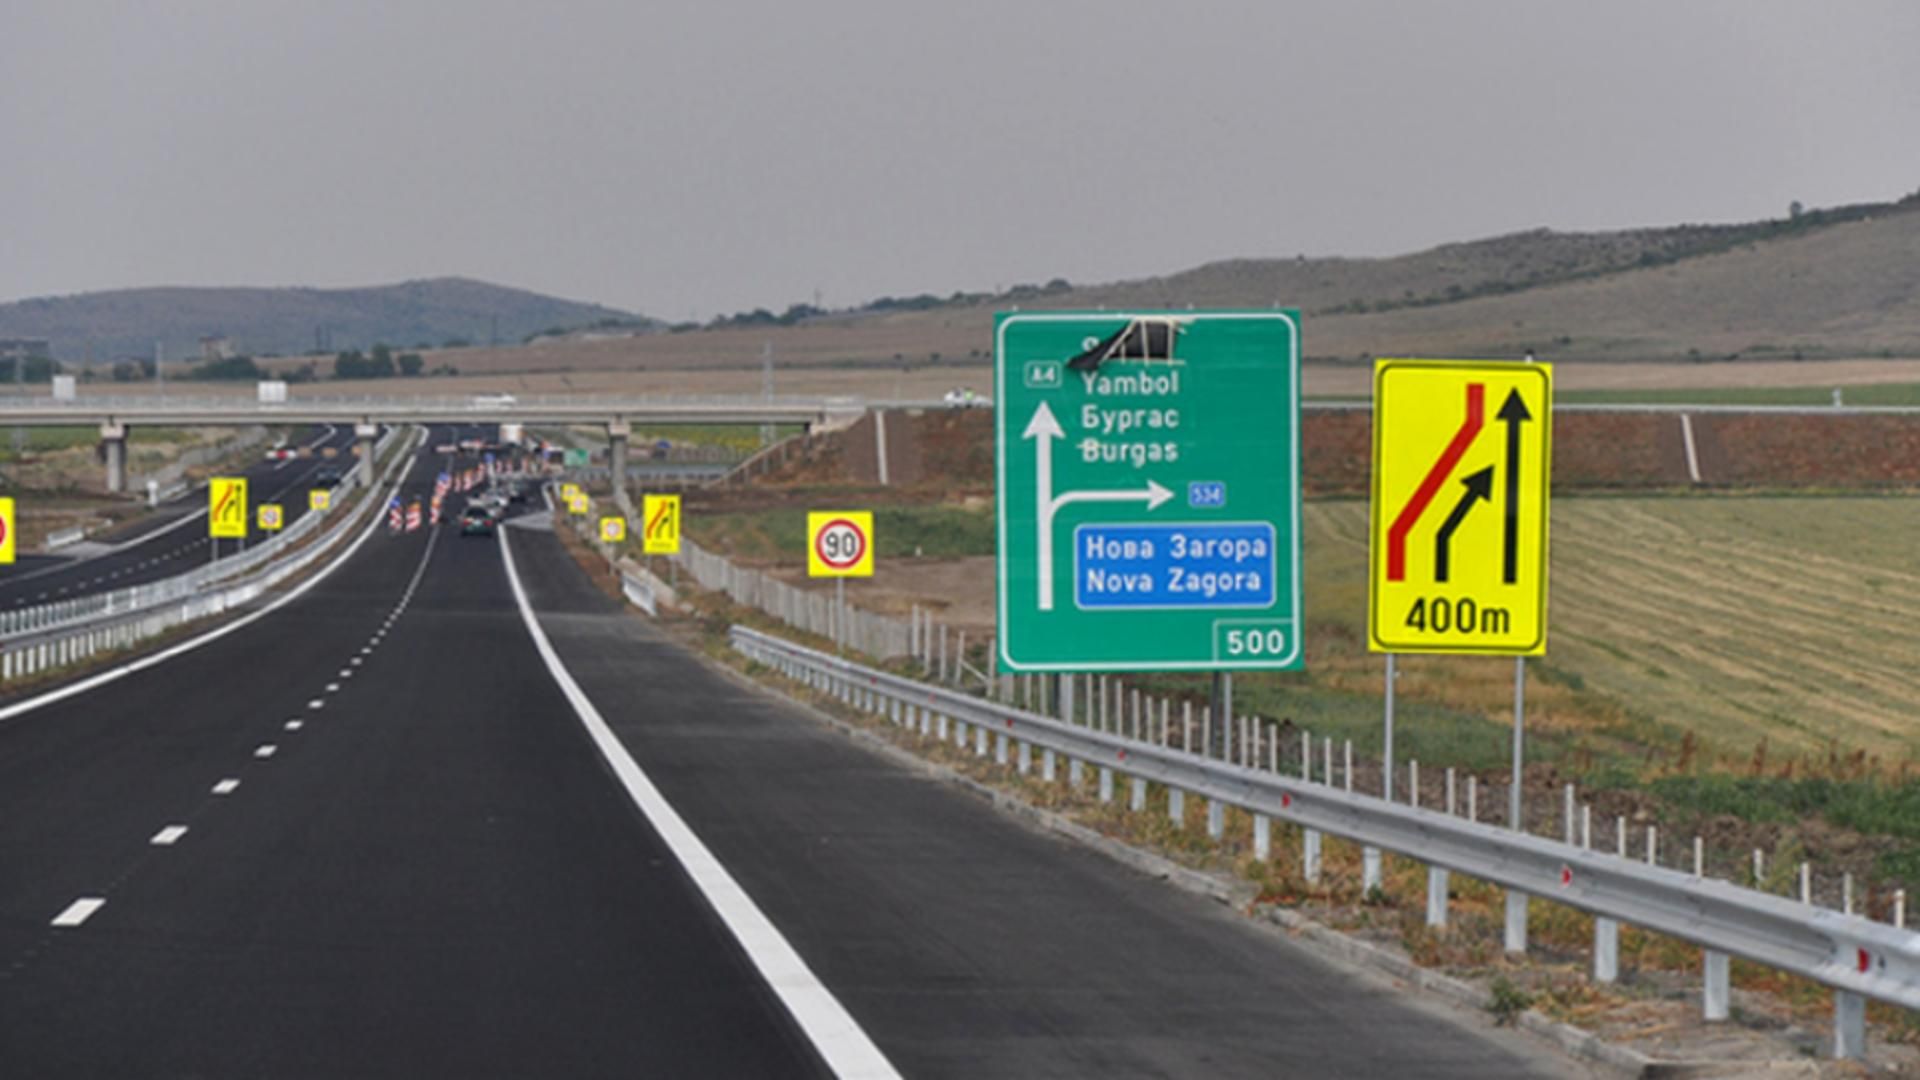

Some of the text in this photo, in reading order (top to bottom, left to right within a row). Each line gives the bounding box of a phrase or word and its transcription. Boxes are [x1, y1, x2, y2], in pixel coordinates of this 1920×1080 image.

[1031, 367, 1055, 382] A4
[1081, 370, 1180, 395] Yambol
[1082, 404, 1180, 435] Бургас
[1082, 438, 1179, 468] Burgas
[825, 531, 856, 559] 90
[1086, 533, 1268, 563] Нова Загора
[1086, 567, 1261, 598] Nova Zagora
[1405, 596, 1510, 634] 400m
[1226, 629, 1284, 654] 500
